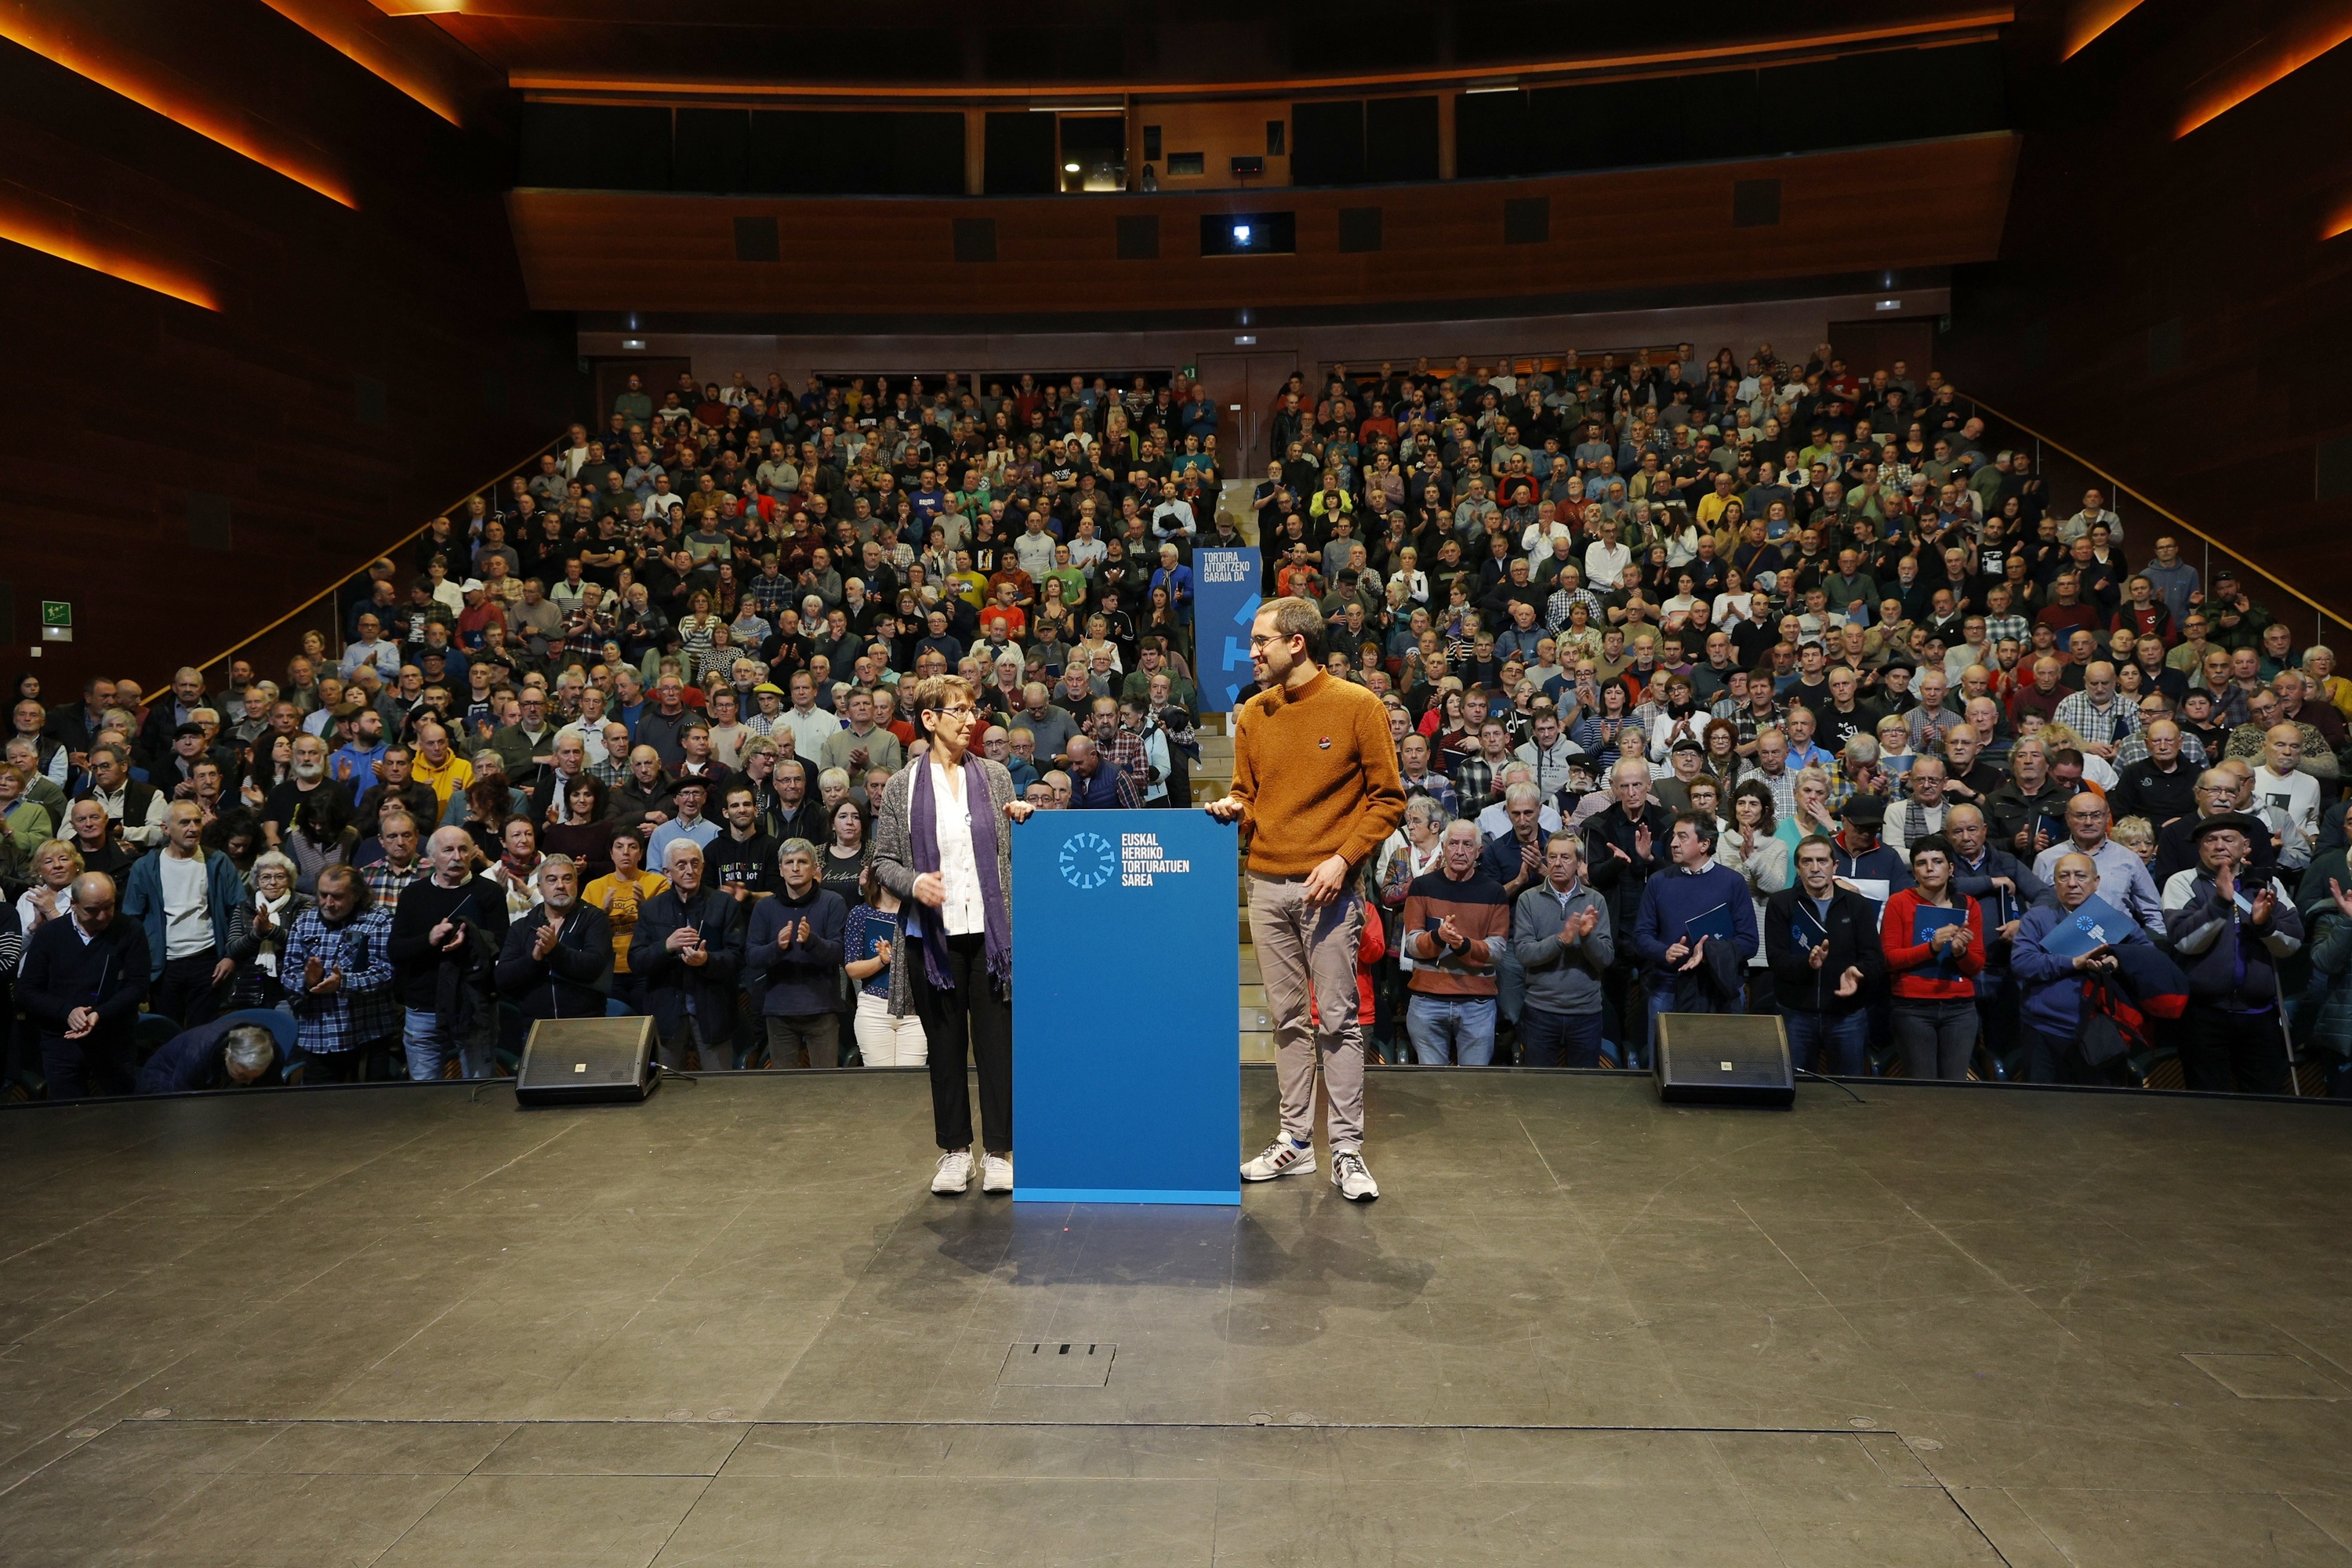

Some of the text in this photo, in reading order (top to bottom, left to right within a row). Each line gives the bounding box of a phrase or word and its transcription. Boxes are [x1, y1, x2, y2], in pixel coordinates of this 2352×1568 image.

[1203, 551, 1239, 562] TORTURA
[1203, 561, 1250, 572] AITORTZEKO
[1203, 572, 1245, 583] GARAIA DA
[1121, 833, 1159, 846] EUSKAL
[1121, 847, 1163, 859] HERRIKO
[1121, 860, 1190, 873] TORTURATUEN
[1121, 873, 1153, 887] SAREA
